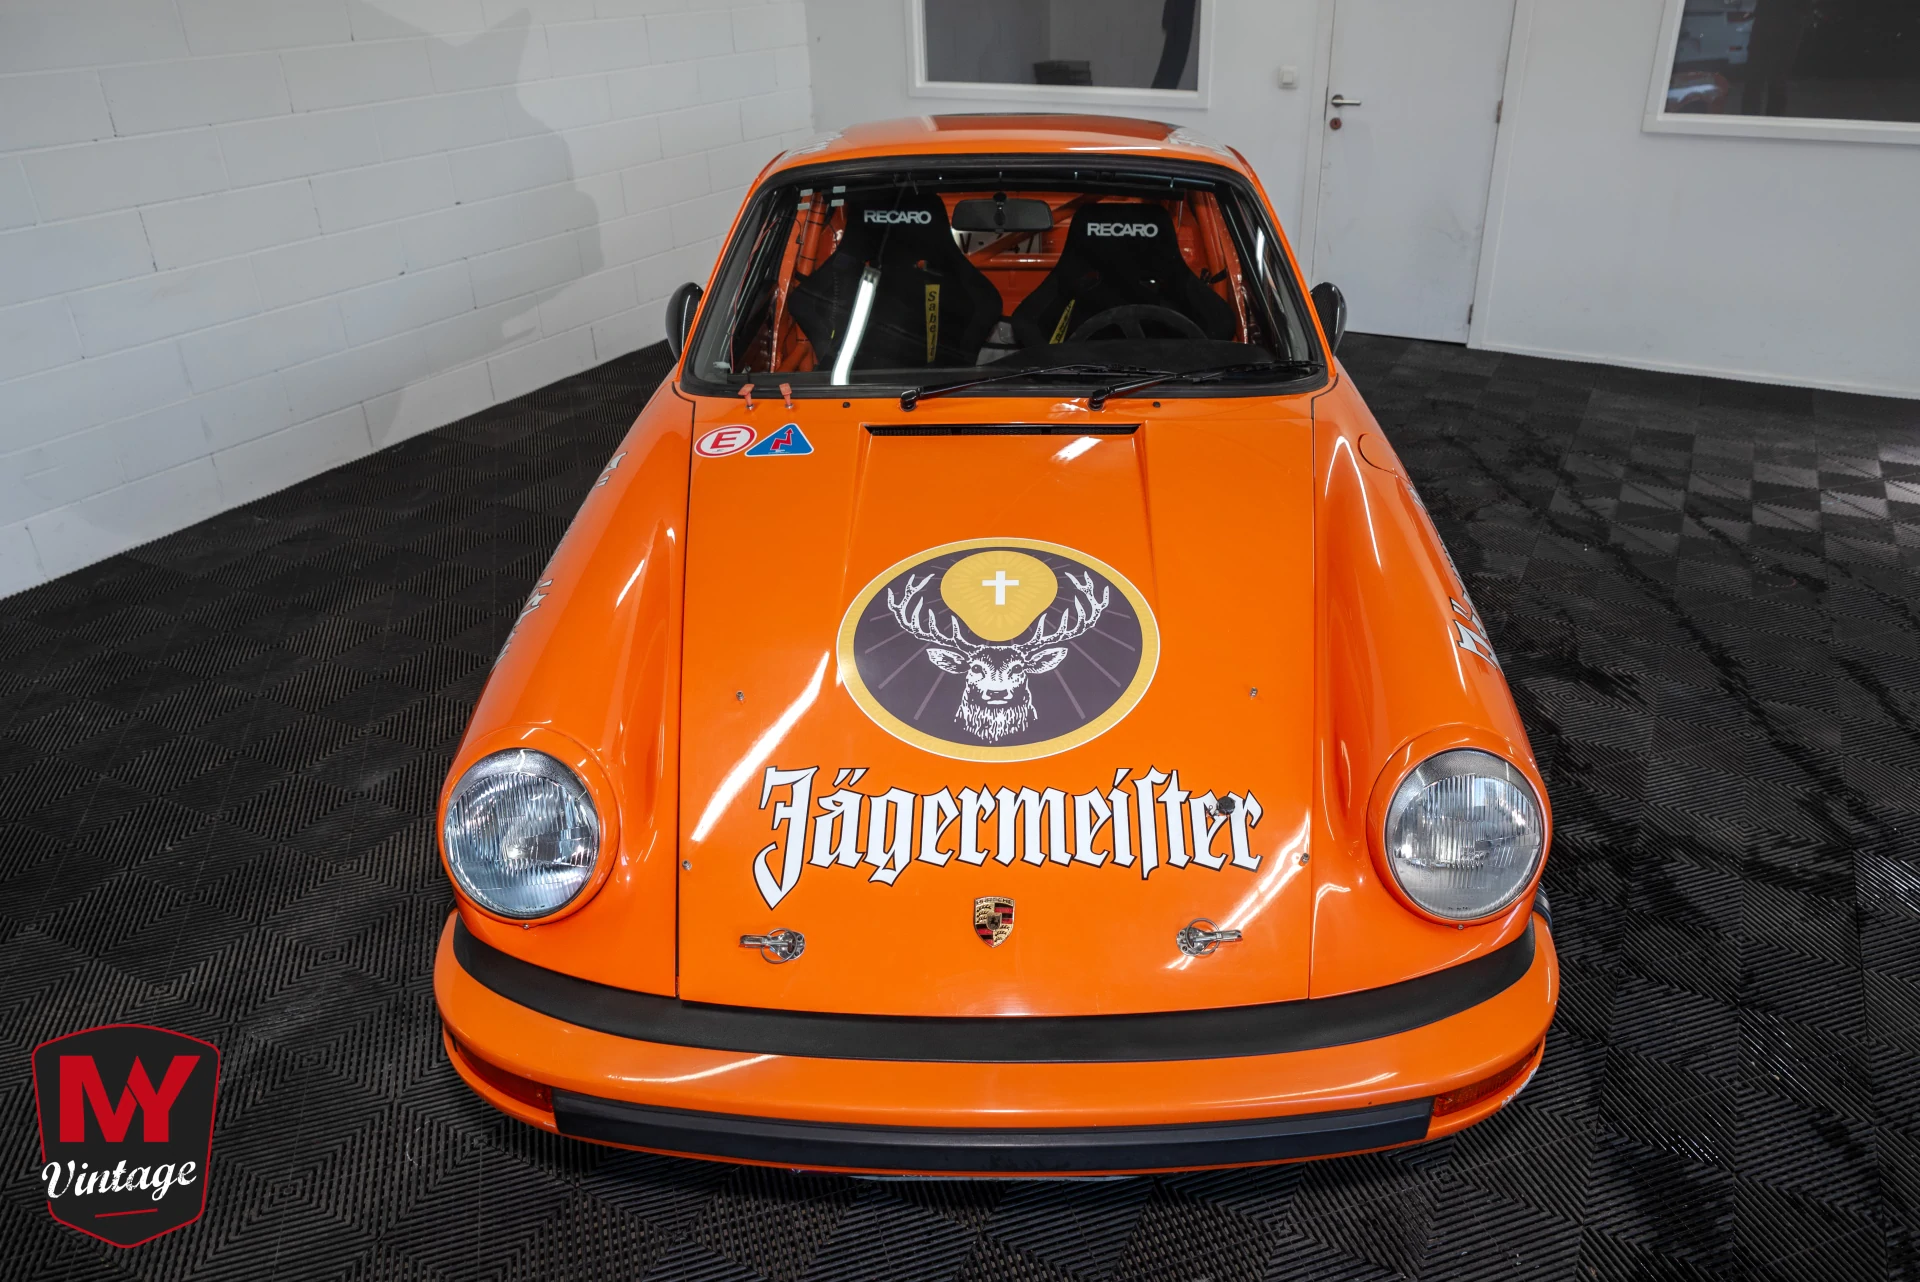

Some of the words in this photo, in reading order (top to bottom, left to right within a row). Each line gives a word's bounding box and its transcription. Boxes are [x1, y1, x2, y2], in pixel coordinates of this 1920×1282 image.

[864, 210, 932, 224] RECARO
[1087, 222, 1159, 238] RECARO
[710, 430, 741, 449] E
